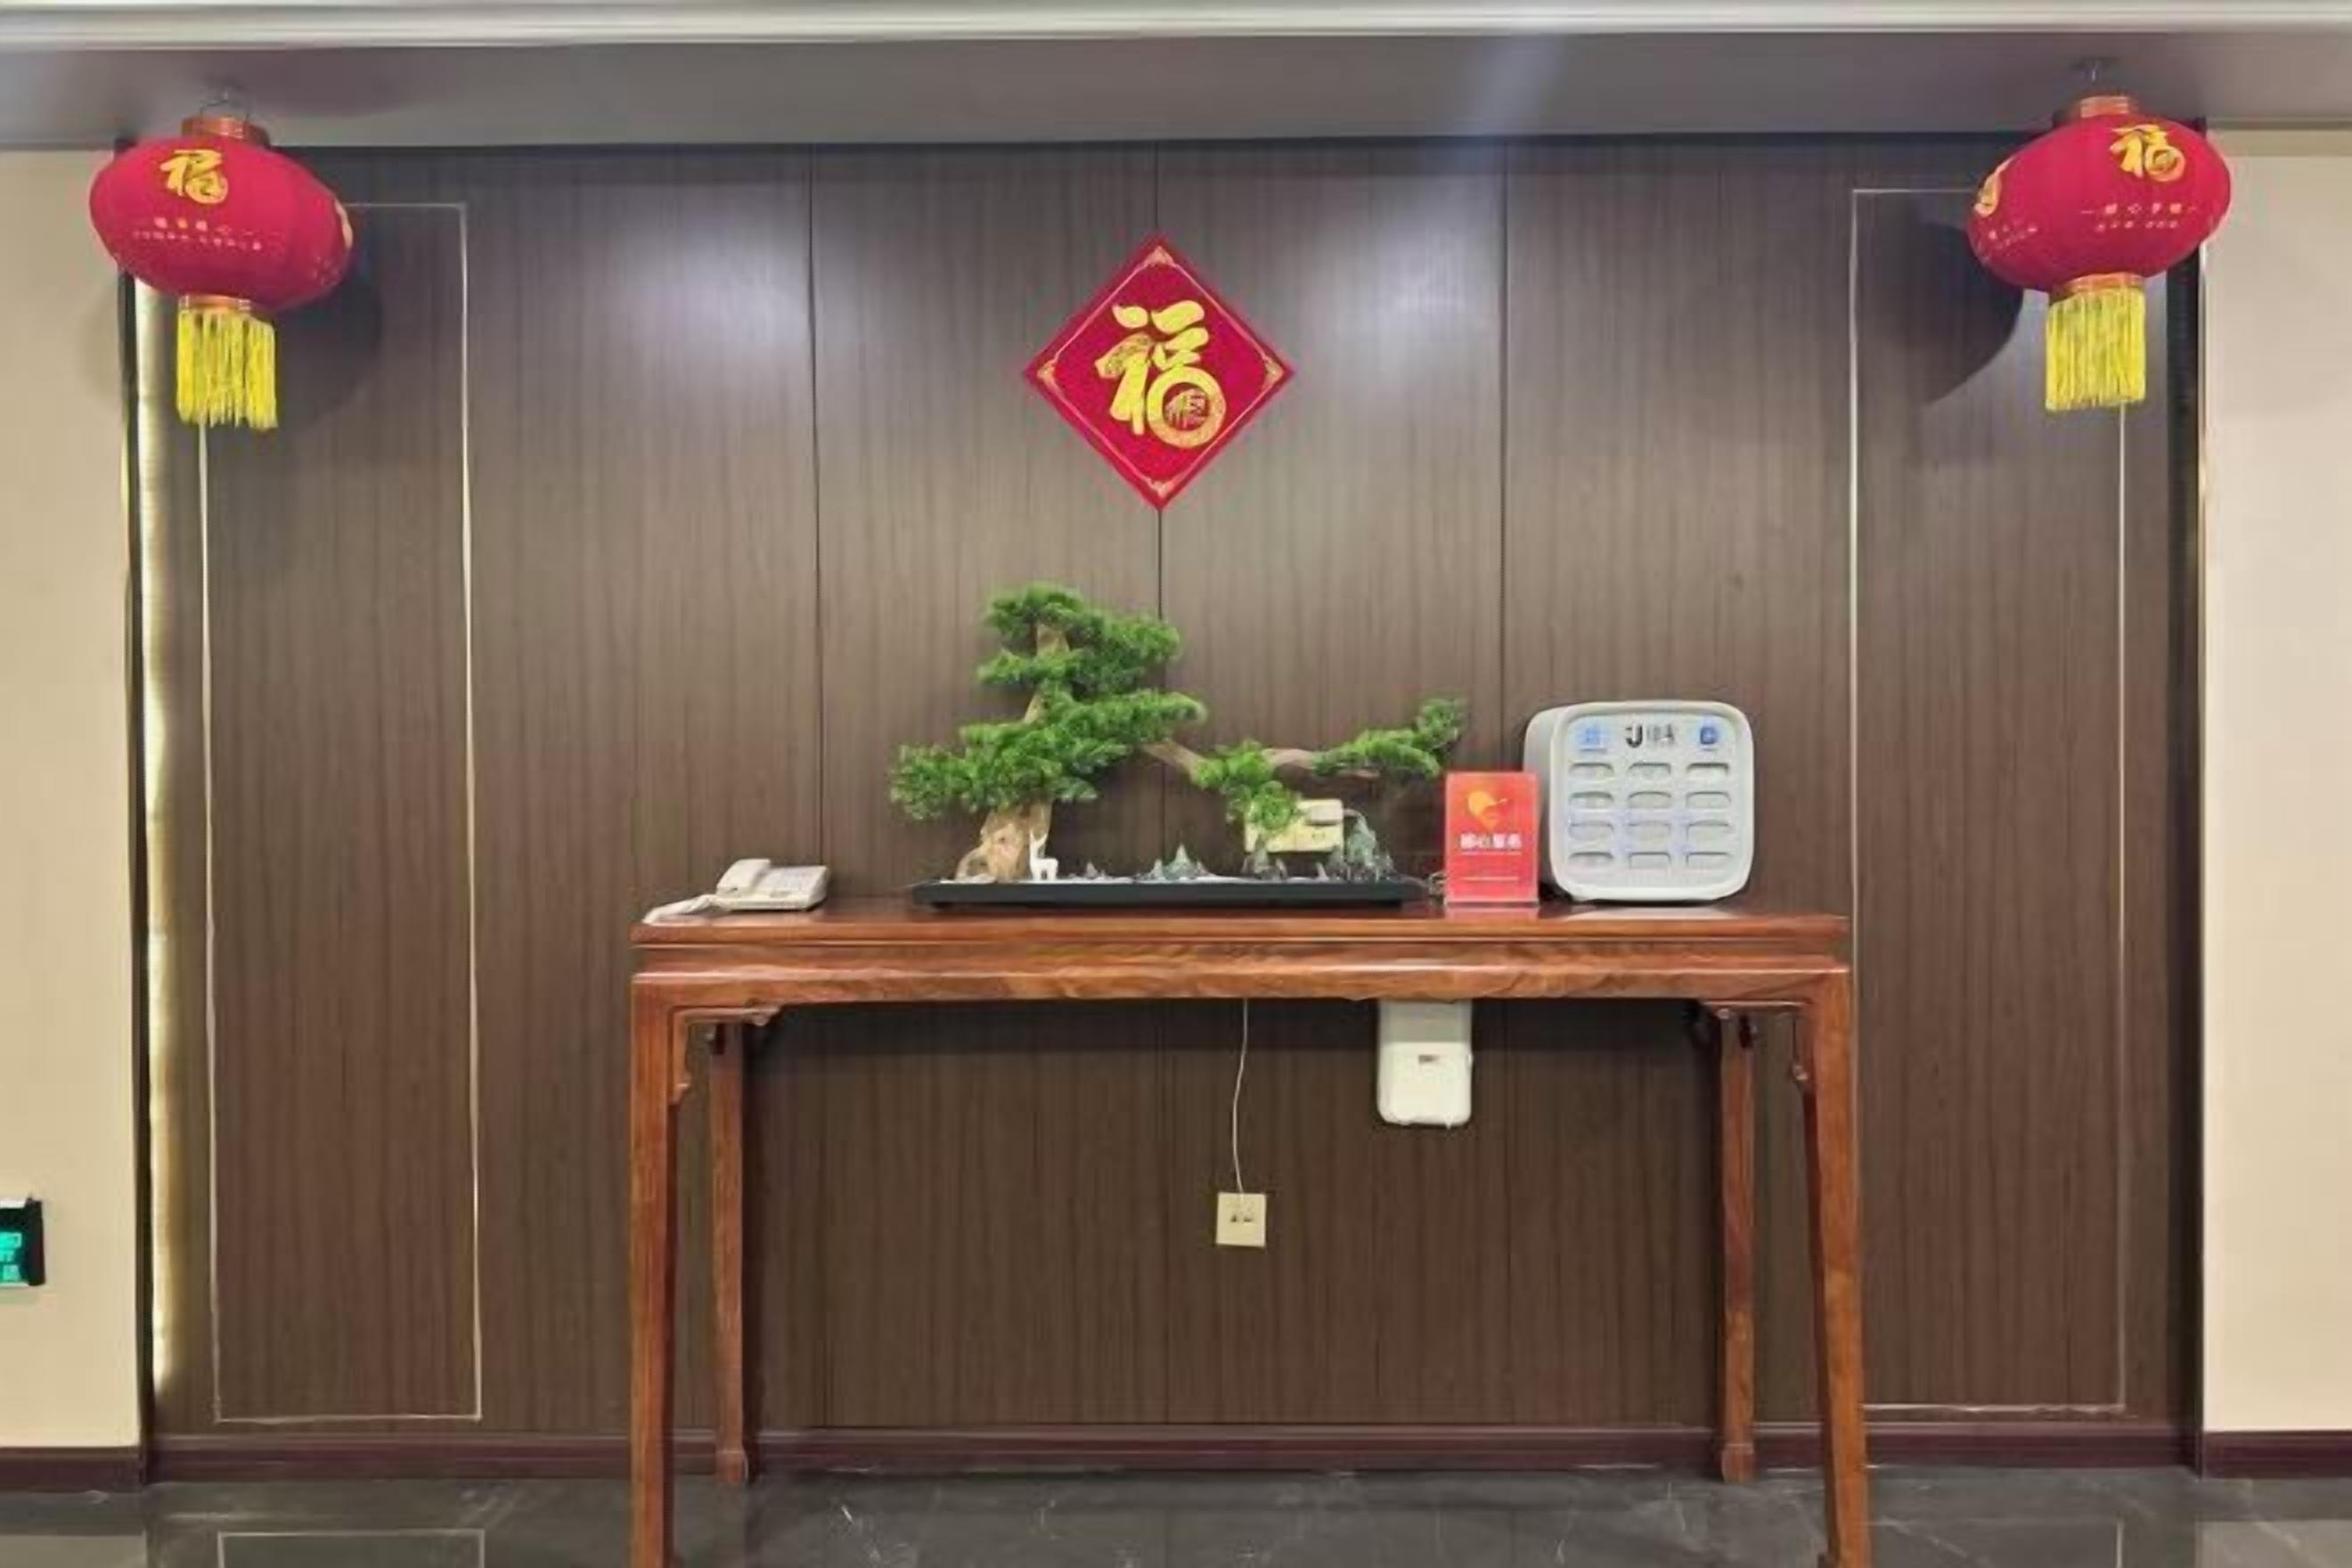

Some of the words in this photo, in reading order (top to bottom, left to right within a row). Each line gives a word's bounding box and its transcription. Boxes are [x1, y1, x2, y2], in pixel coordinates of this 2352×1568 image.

[159, 149, 229, 204] 福
[2110, 125, 2185, 182] 福
[1094, 300, 1227, 449] 福
